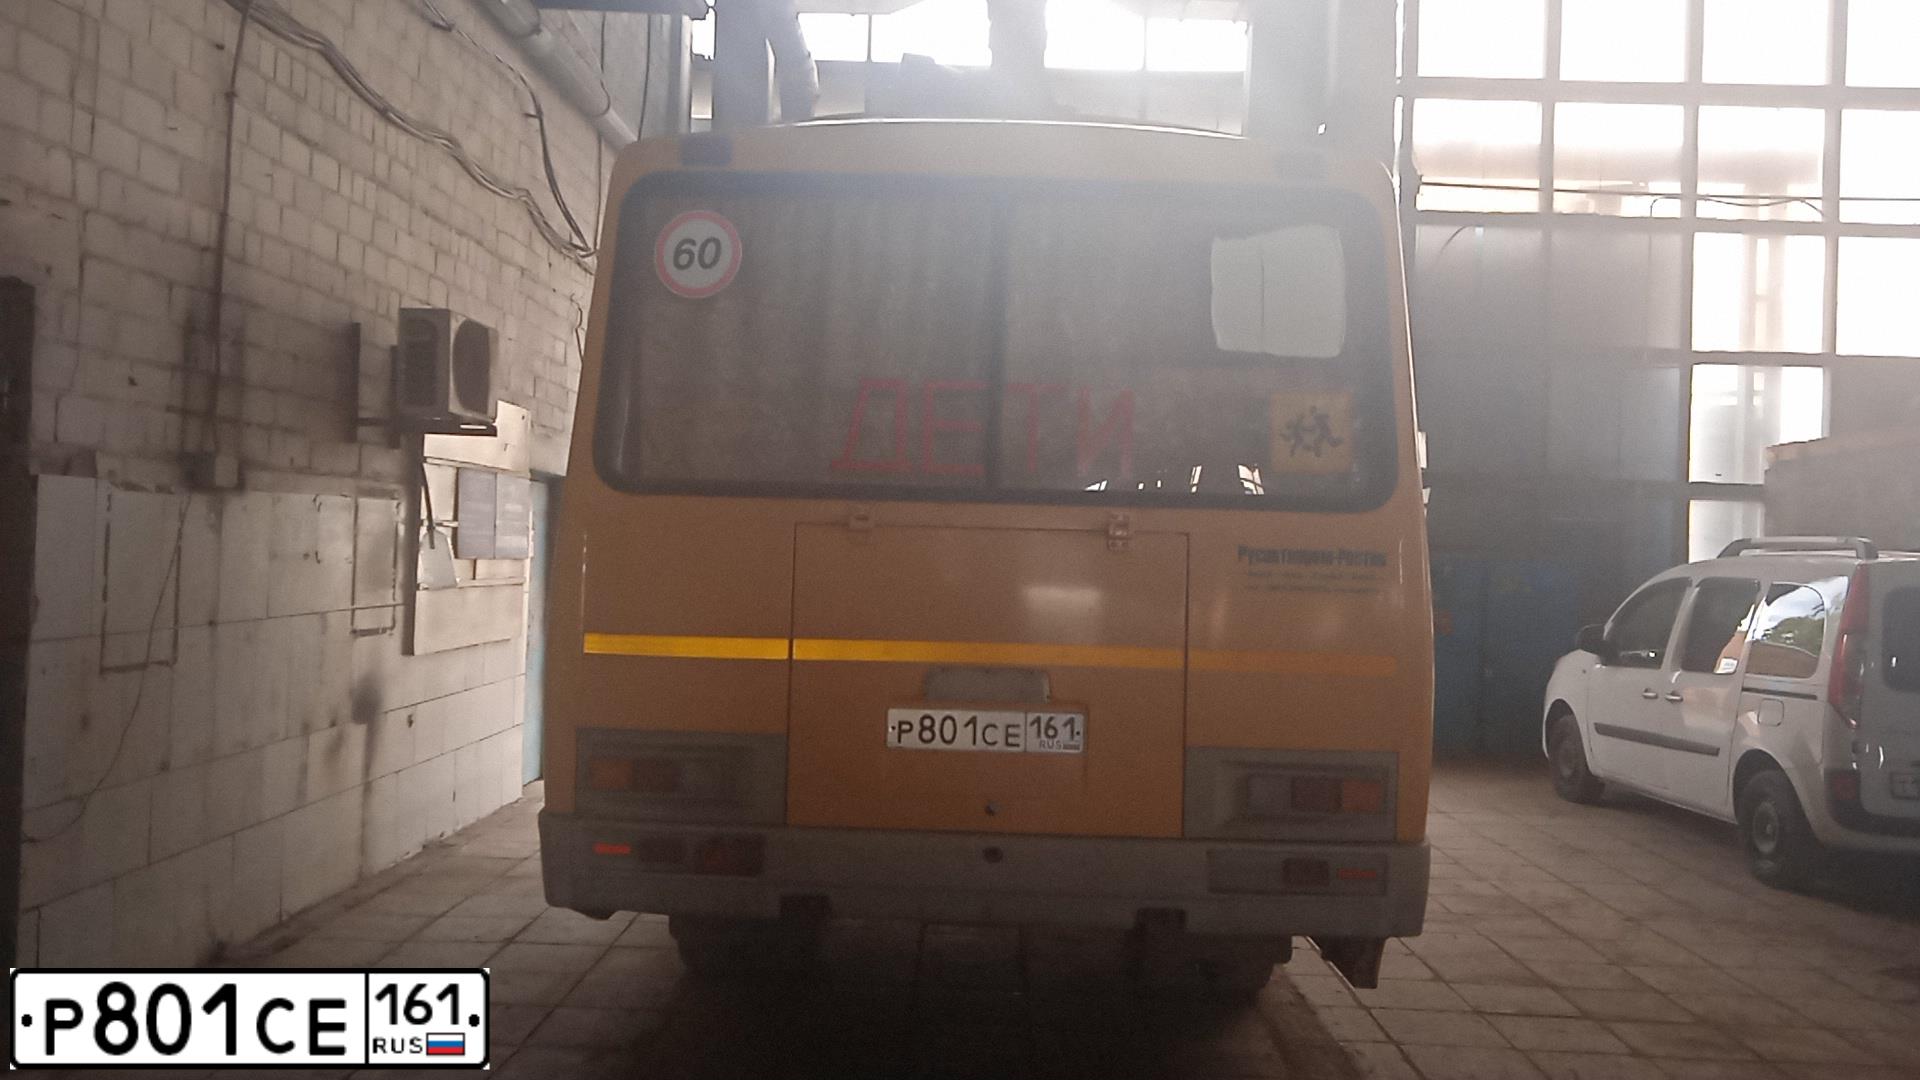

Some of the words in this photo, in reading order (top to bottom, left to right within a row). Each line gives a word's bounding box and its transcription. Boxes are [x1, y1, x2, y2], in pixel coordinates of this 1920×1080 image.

[673, 236, 722, 271] 60
[831, 377, 1135, 480] ДЕТИ
[1030, 715, 1075, 742] 161
[1039, 740, 1062, 750] RUS
